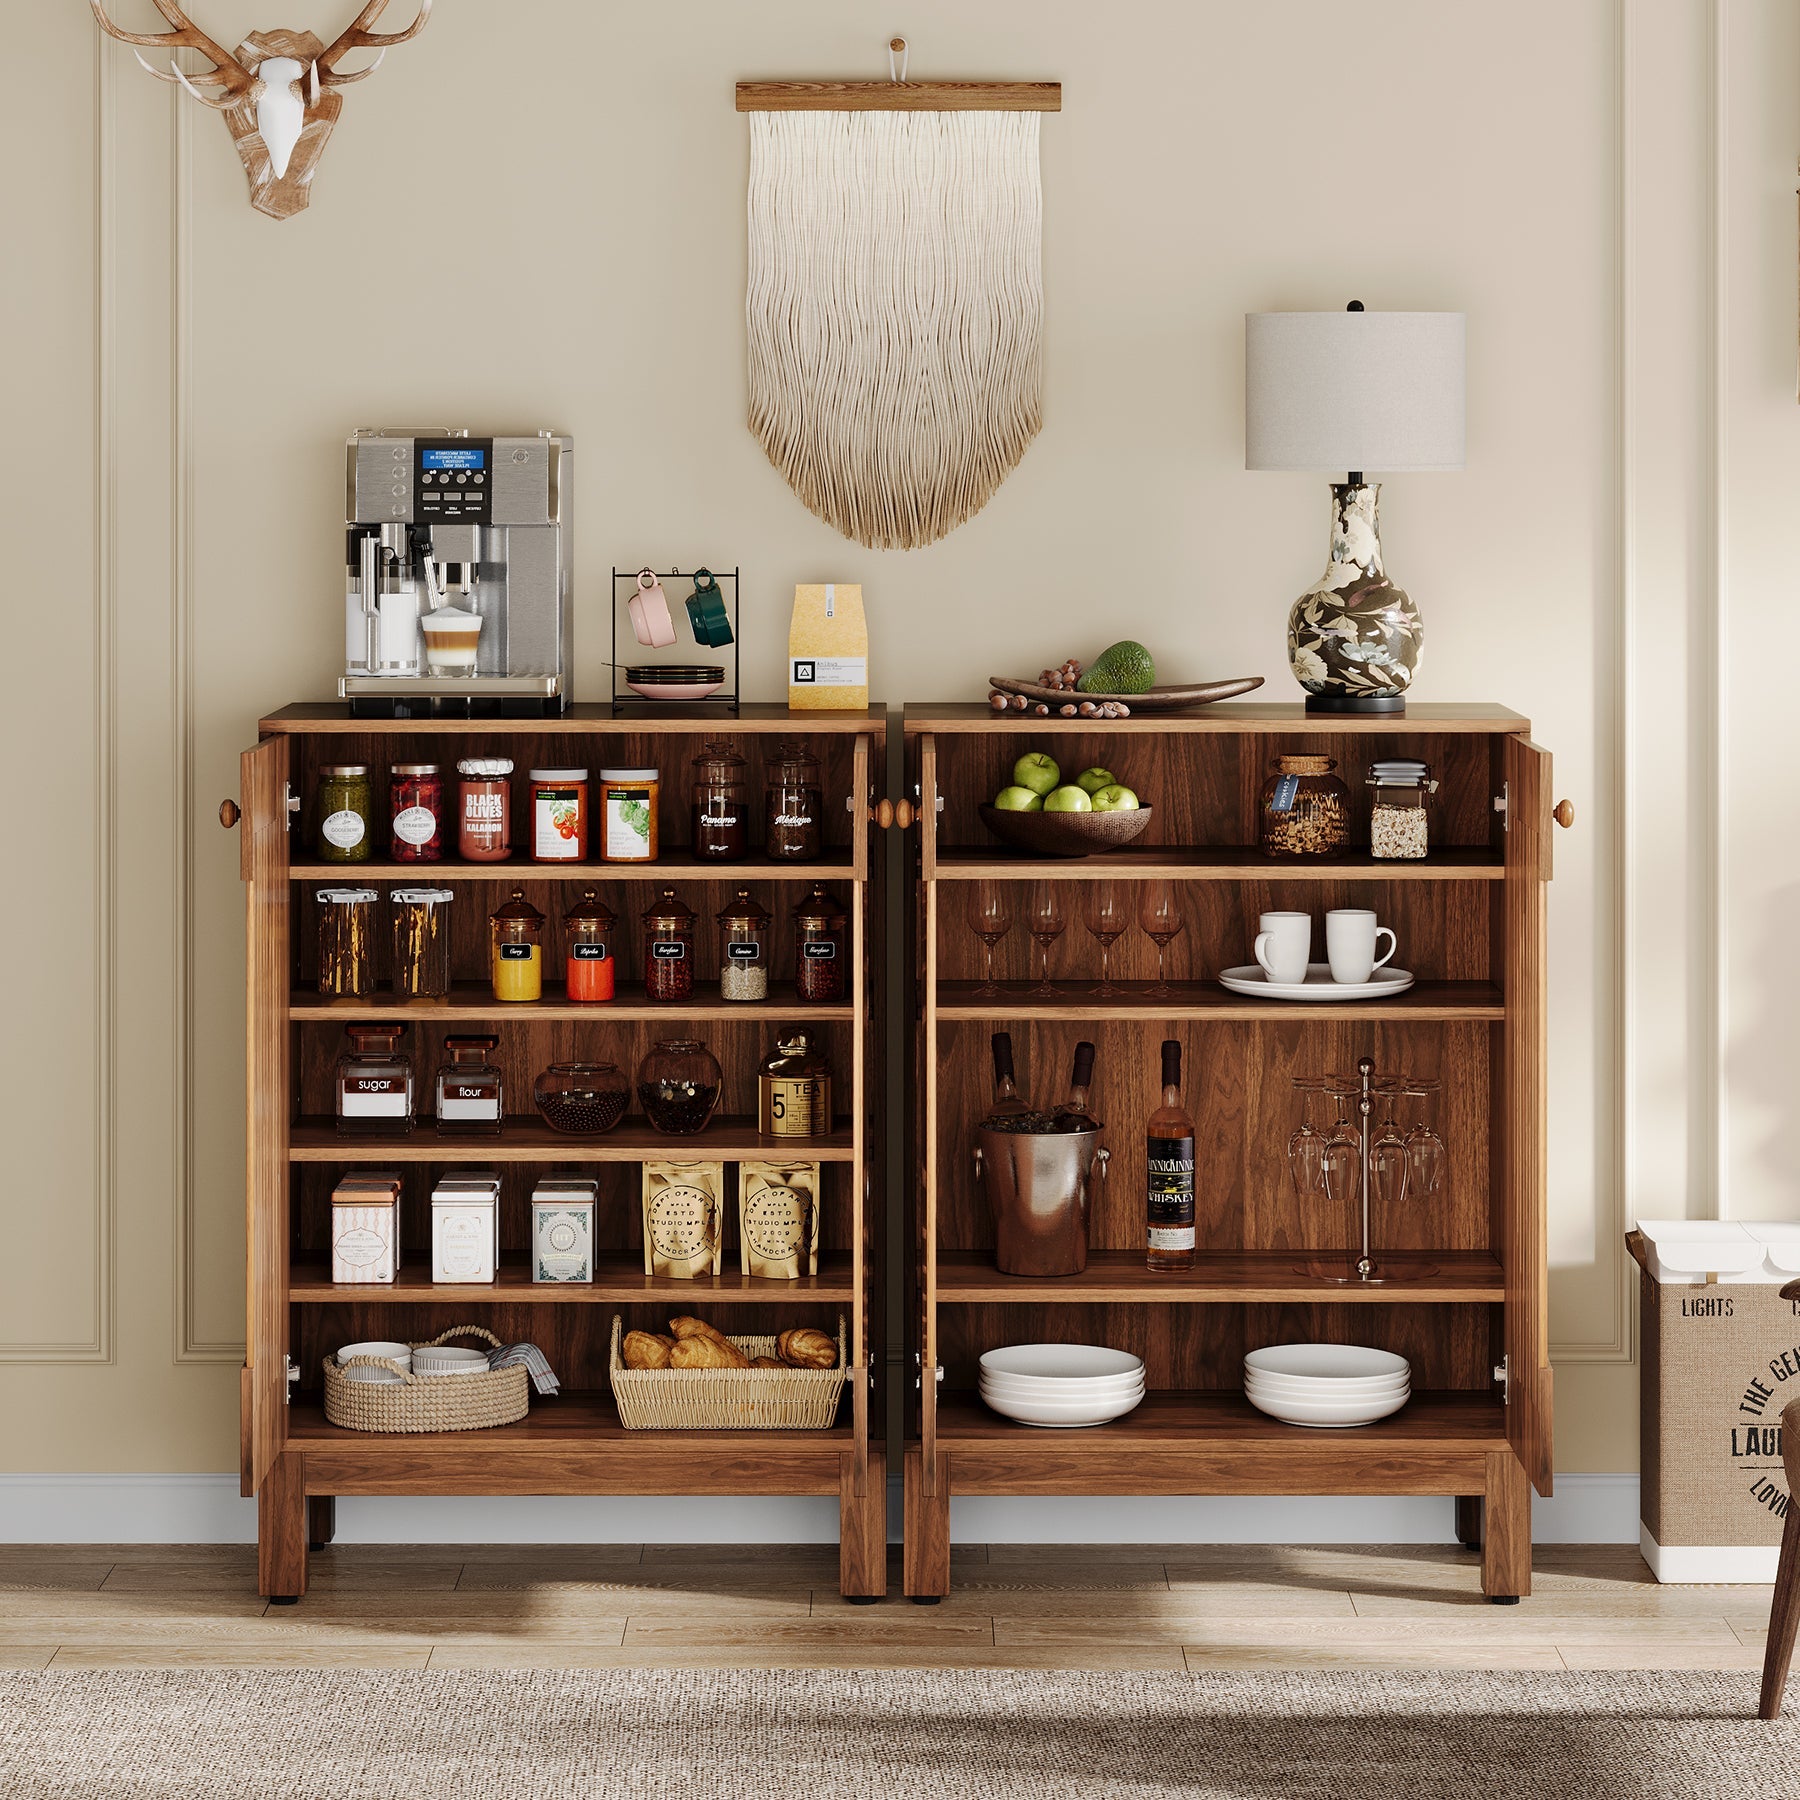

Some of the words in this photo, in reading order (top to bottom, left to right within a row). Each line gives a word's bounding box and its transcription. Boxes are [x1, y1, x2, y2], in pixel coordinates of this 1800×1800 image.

[466, 794, 502, 806] BLACK
[466, 806, 502, 818] OLIVES
[701, 814, 736, 823] Panama
[466, 823, 502, 832] KALAMON
[358, 1079, 391, 1091] sugar
[793, 1084, 820, 1094] TEA
[459, 1087, 482, 1097] flour
[772, 1093, 785, 1119] 5
[1682, 1298, 1734, 1317] LIGHTS
[1739, 1377, 1774, 1416] THE
